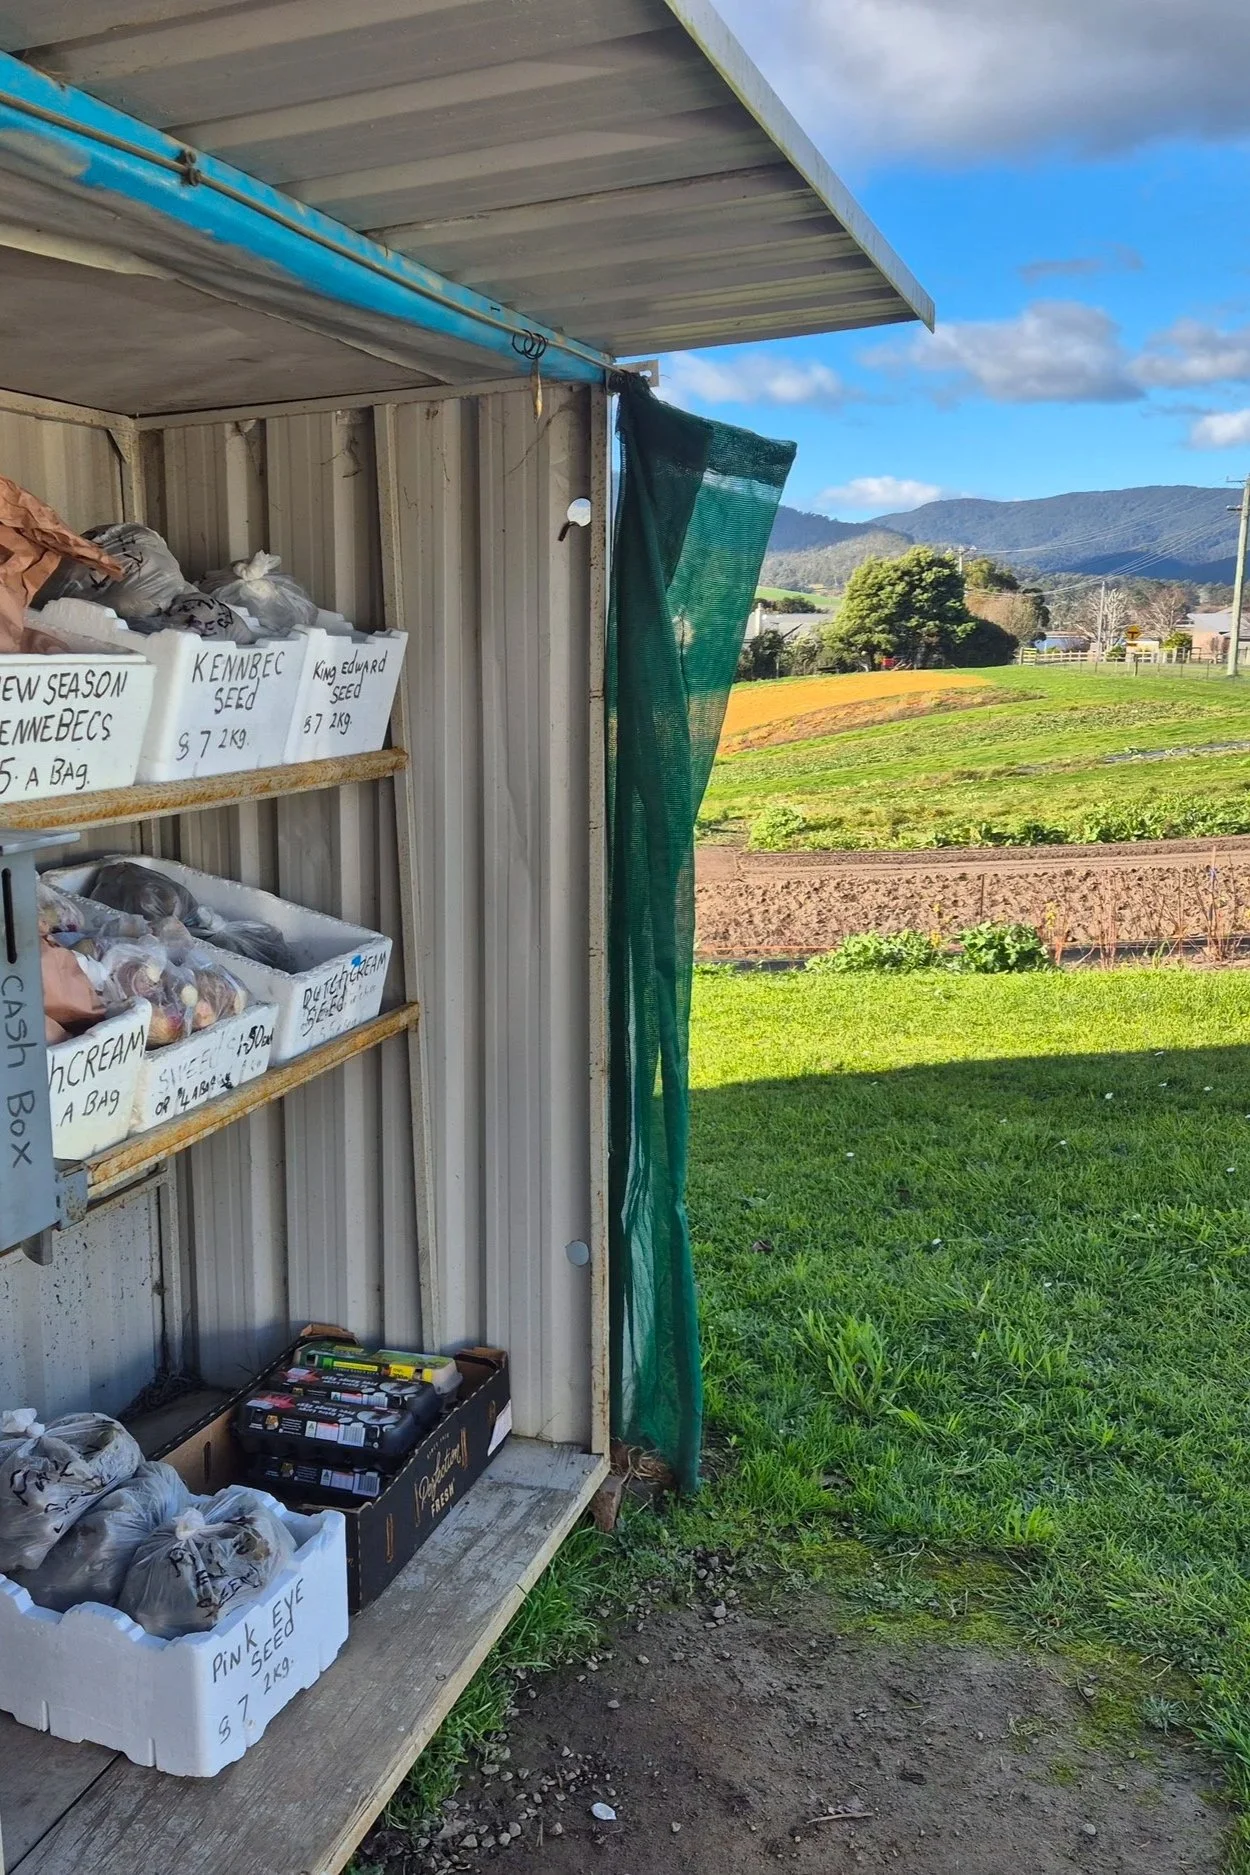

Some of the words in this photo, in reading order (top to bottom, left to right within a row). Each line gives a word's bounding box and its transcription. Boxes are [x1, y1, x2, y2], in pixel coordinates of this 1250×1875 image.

[191, 651, 285, 683] KENNBEC
[0, 675, 41, 703] EW
[43, 669, 128, 705] SEASON
[0, 708, 113, 746] ENNEBECS
[25, 767, 39, 791] A
[431, 1480, 455, 1518] FRESH
